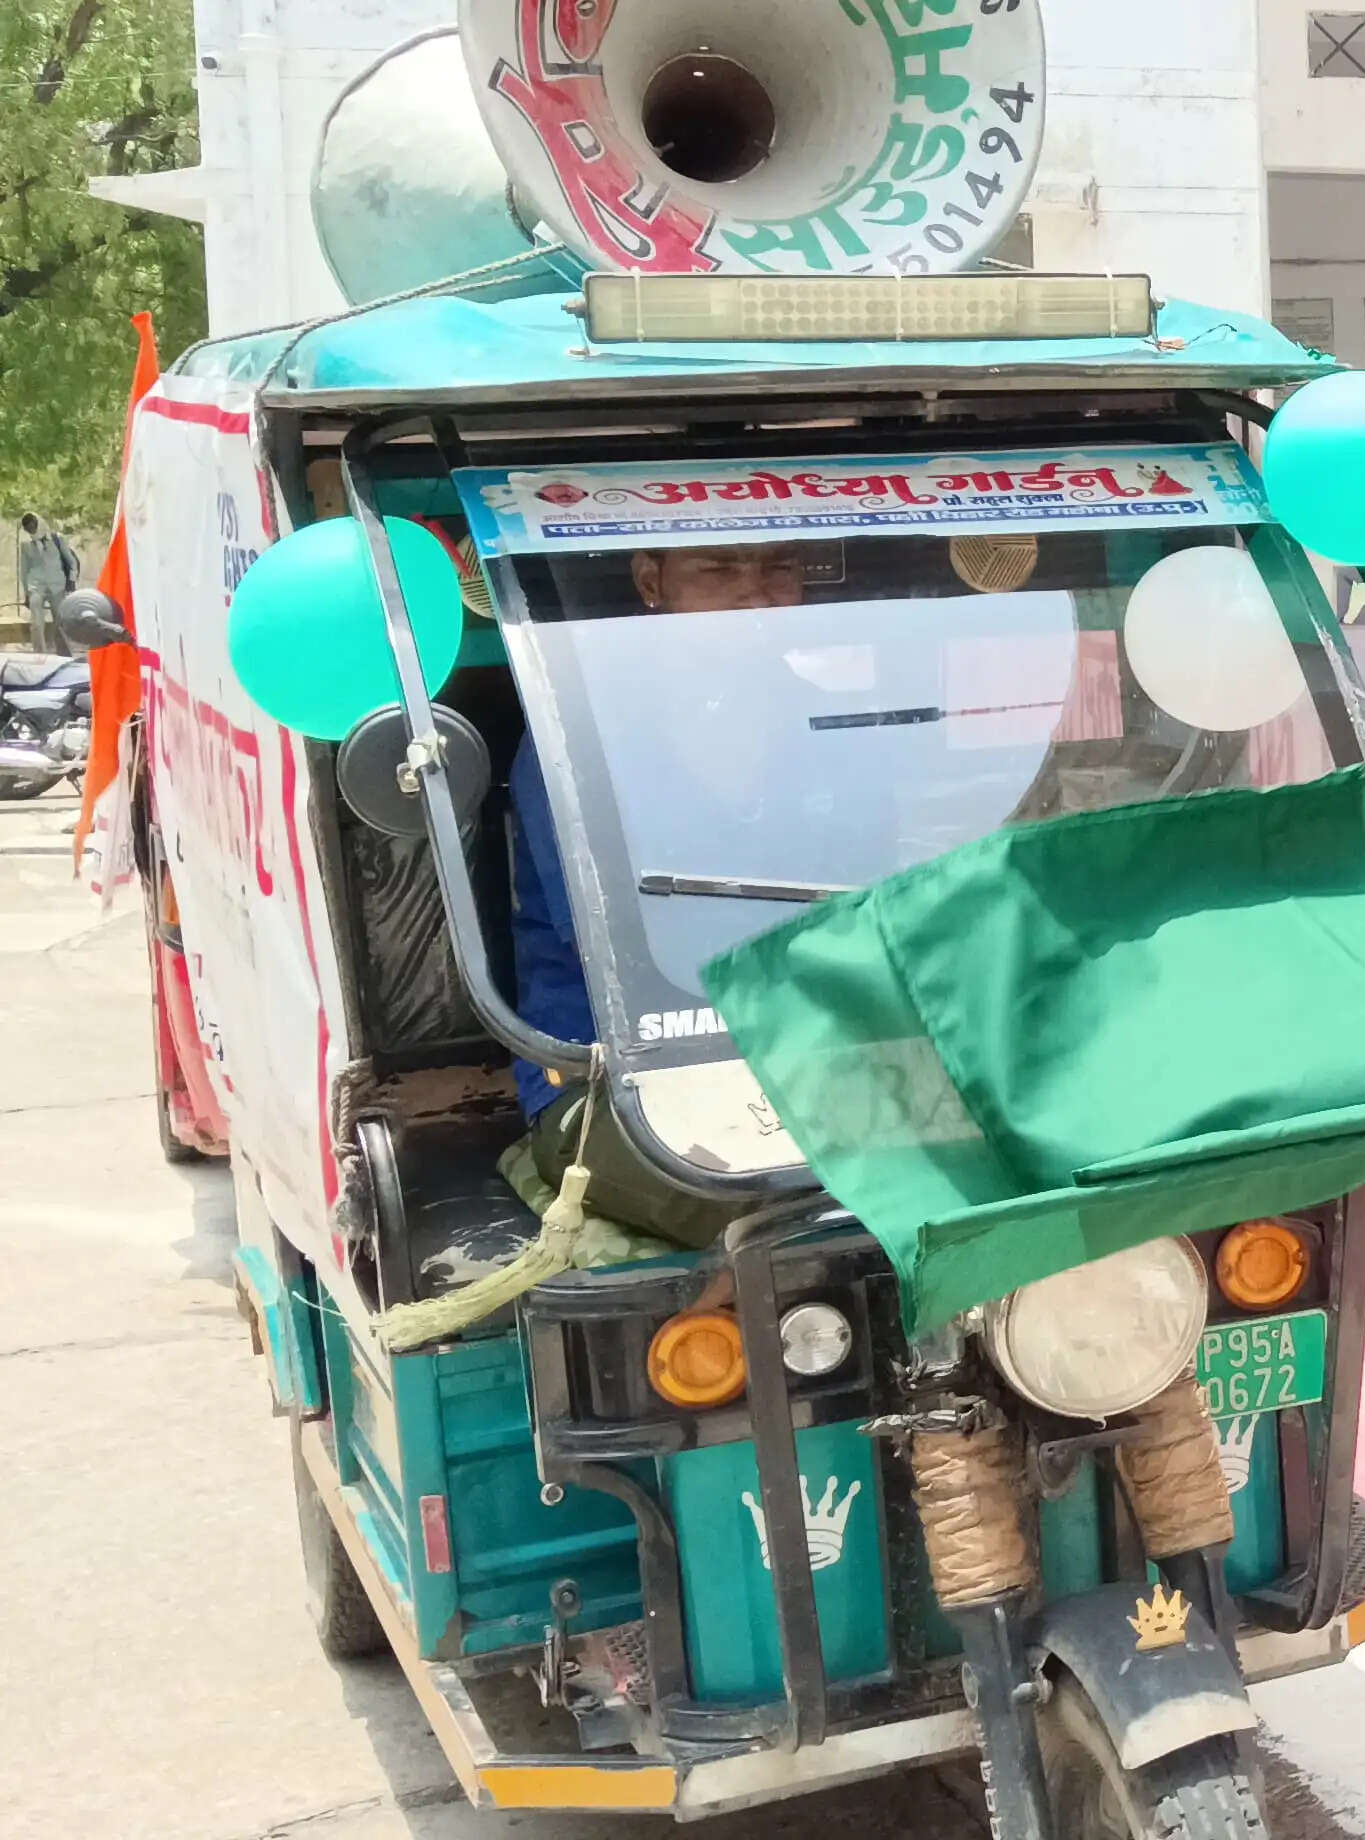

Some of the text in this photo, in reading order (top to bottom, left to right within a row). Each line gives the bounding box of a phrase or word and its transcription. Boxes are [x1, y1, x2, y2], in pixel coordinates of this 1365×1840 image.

[634, 471, 938, 505] अयोध्या
[1203, 1321, 1296, 1373] P95A
[1206, 1364, 1297, 1414] 0672
